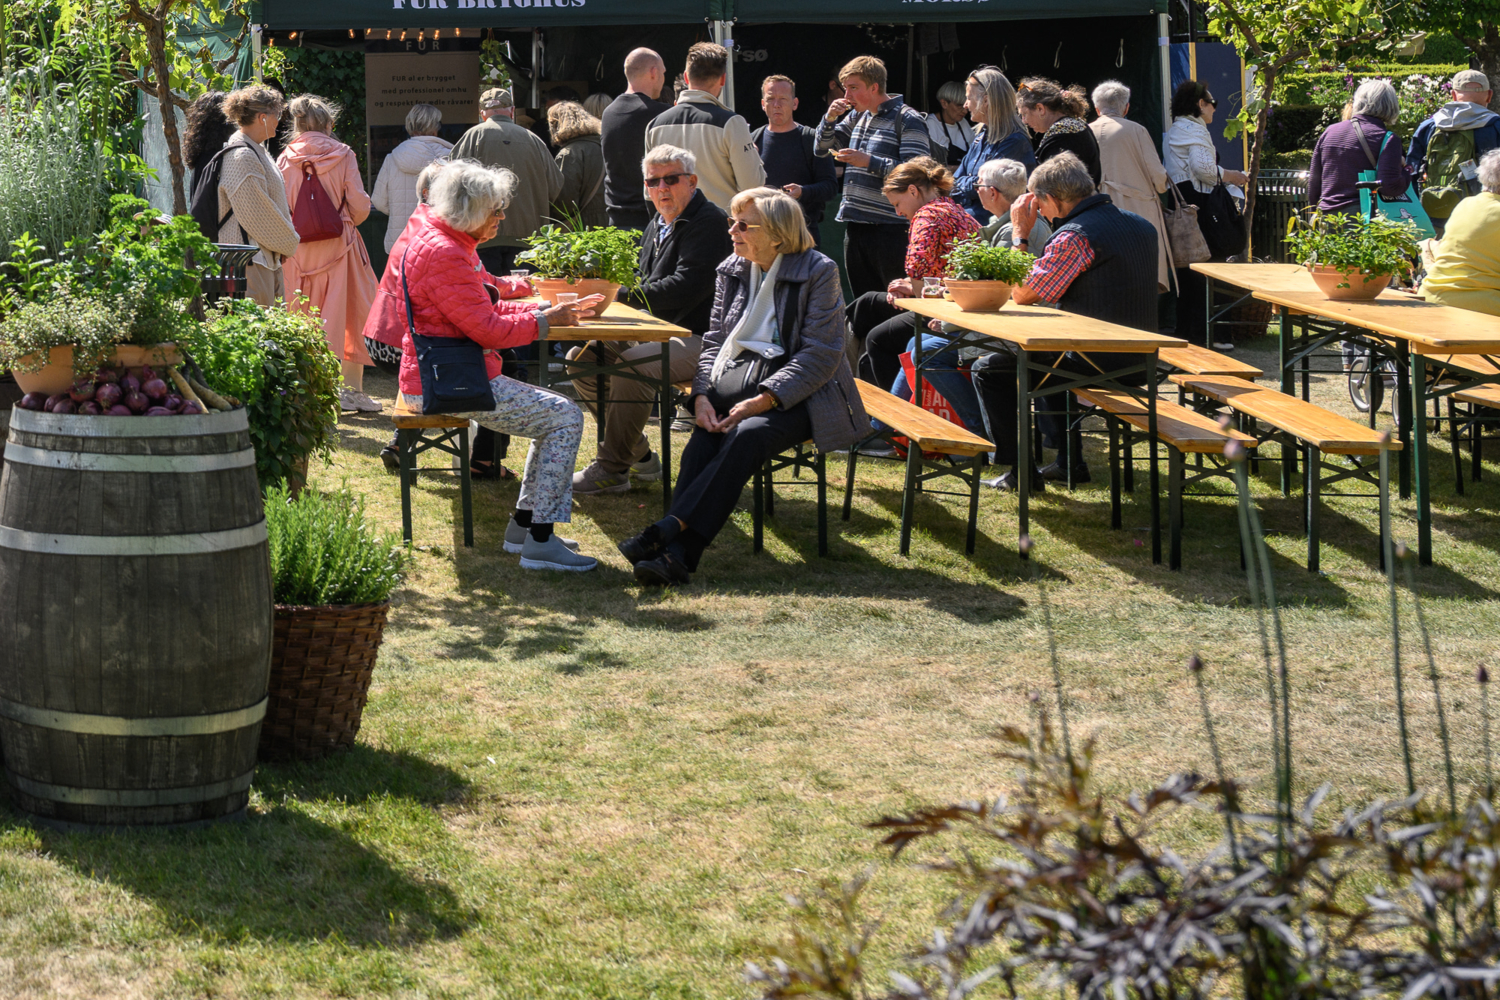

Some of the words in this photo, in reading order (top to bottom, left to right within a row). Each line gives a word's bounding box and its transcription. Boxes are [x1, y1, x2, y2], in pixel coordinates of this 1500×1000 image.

[405, 40, 440, 51] FUR
[426, 74, 456, 83] brygget
[399, 86, 445, 96] professionel
[386, 99, 414, 107] respekt
